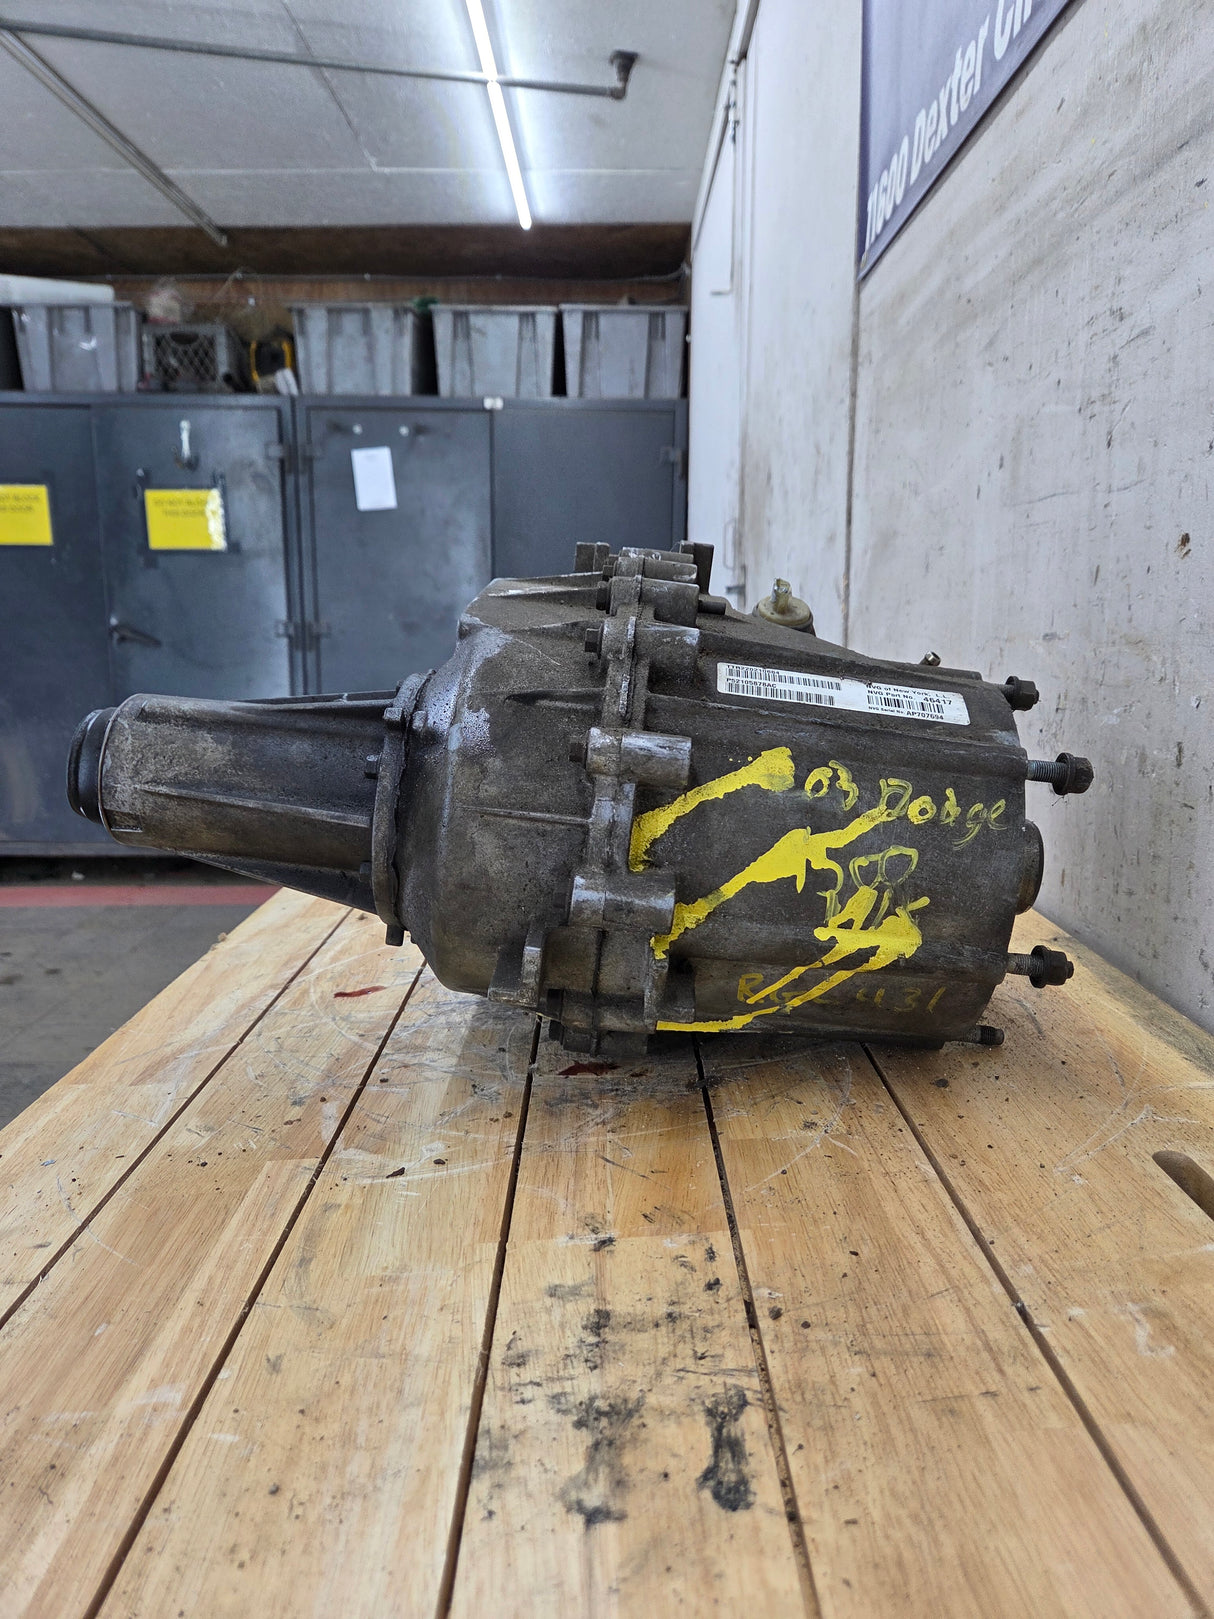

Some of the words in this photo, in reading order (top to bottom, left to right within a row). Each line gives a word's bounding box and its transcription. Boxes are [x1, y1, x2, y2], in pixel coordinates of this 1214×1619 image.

[910, 14, 990, 186] Dexter
[726, 678, 777, 688] P52105878AC
[923, 697, 952, 705] 46417
[906, 711, 944, 720] AP707694
[804, 760, 859, 811] 03
[879, 777, 1008, 850] Dodge
